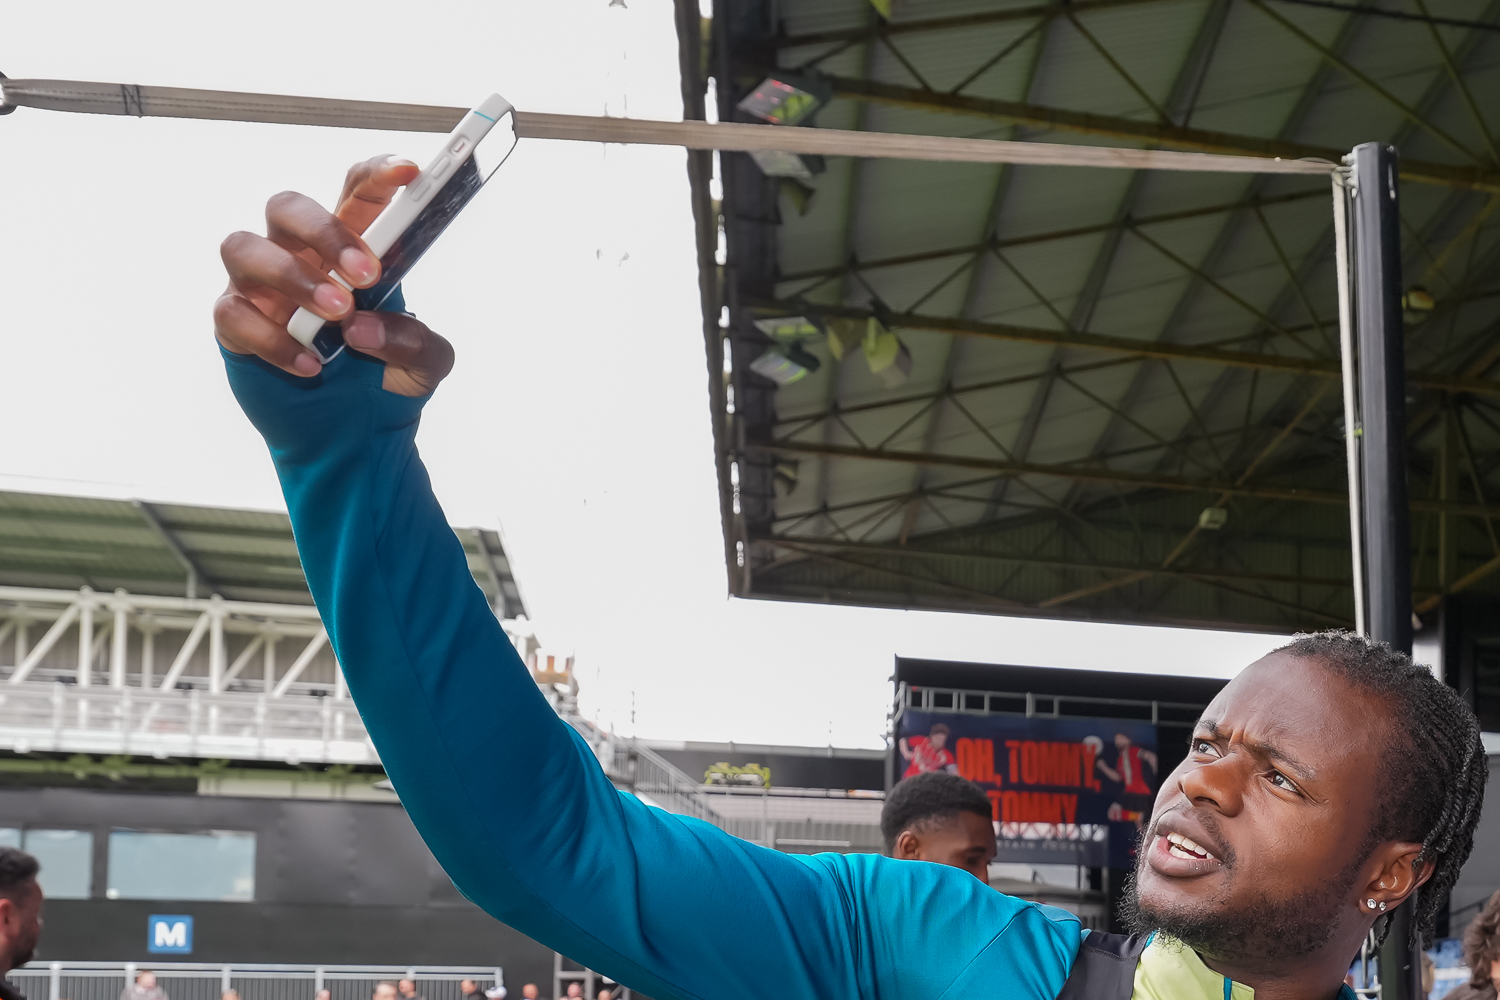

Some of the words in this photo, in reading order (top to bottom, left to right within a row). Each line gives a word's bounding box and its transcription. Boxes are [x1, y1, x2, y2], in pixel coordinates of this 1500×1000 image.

[956, 737, 1002, 787] OH,
[1005, 740, 1101, 792] TOMMY,
[987, 790, 1078, 824] TOMMY
[155, 921, 187, 948] M
